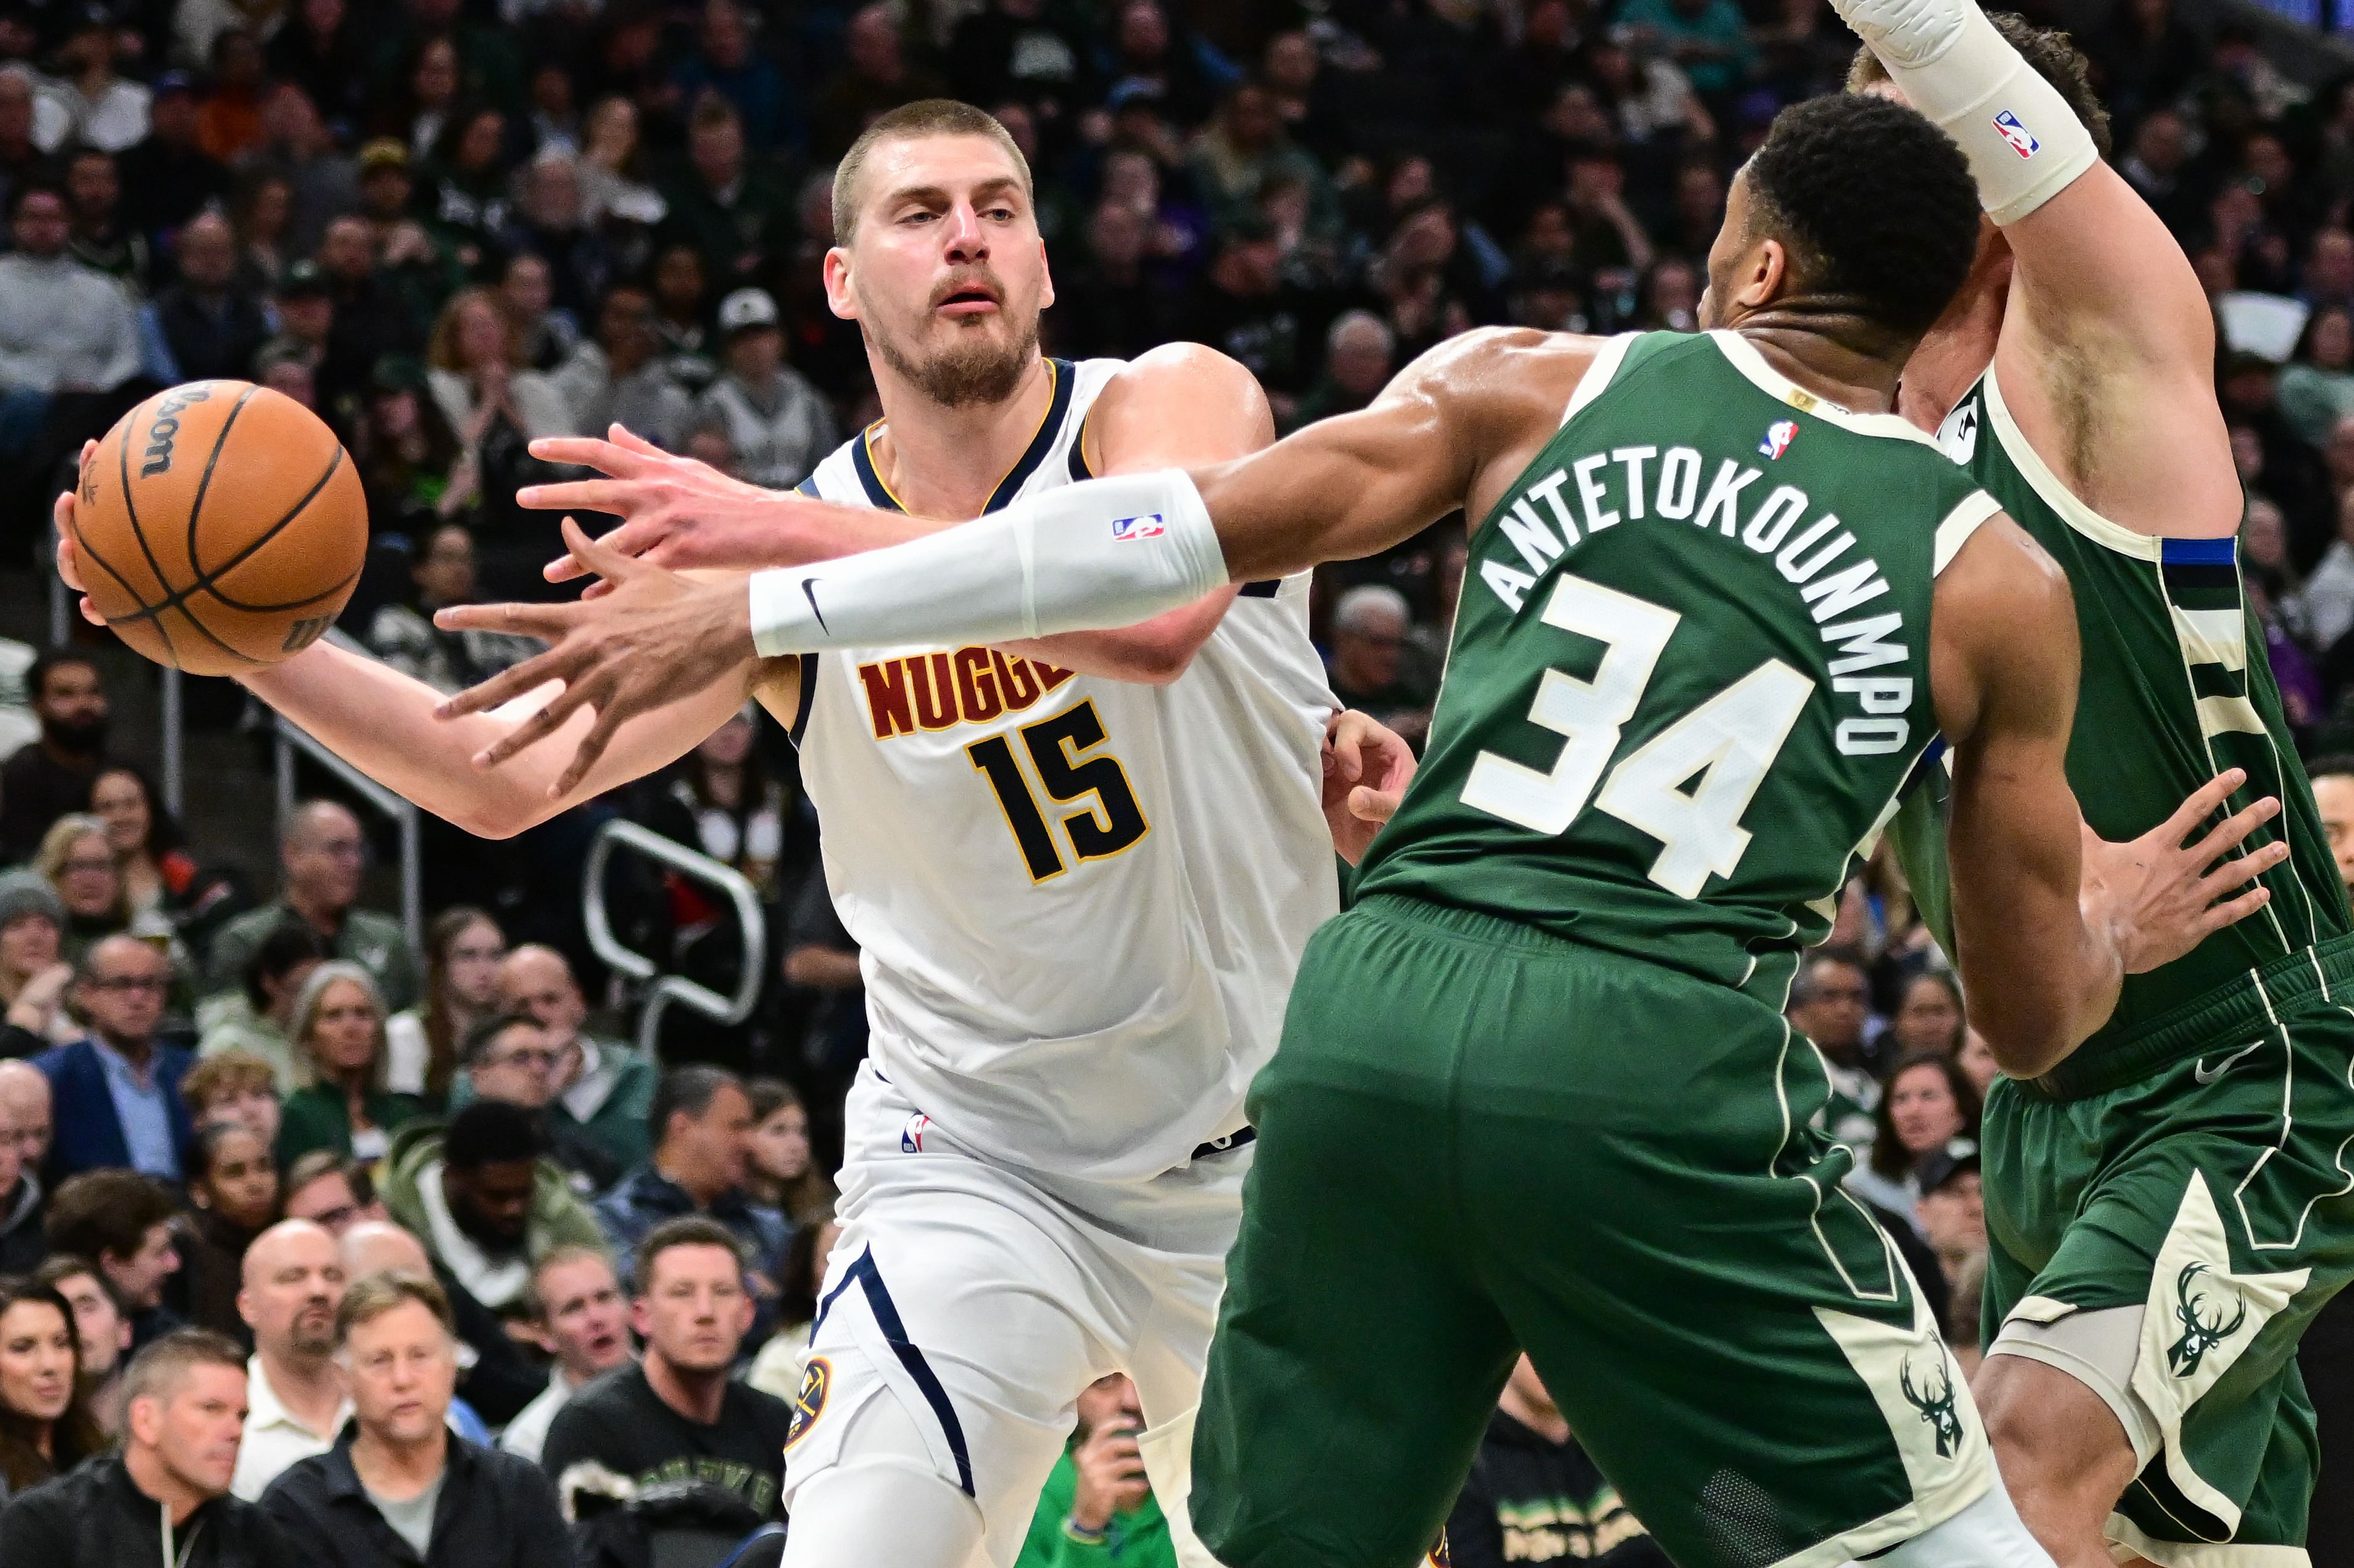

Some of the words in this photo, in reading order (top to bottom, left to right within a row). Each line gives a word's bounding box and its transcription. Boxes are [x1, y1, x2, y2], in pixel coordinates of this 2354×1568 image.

[1759, 444, 1774, 456] NBA
[1481, 445, 1913, 756] ANTETOKOUNMPO
[963, 695, 1151, 886] 15
[1460, 572, 1816, 900] 34
